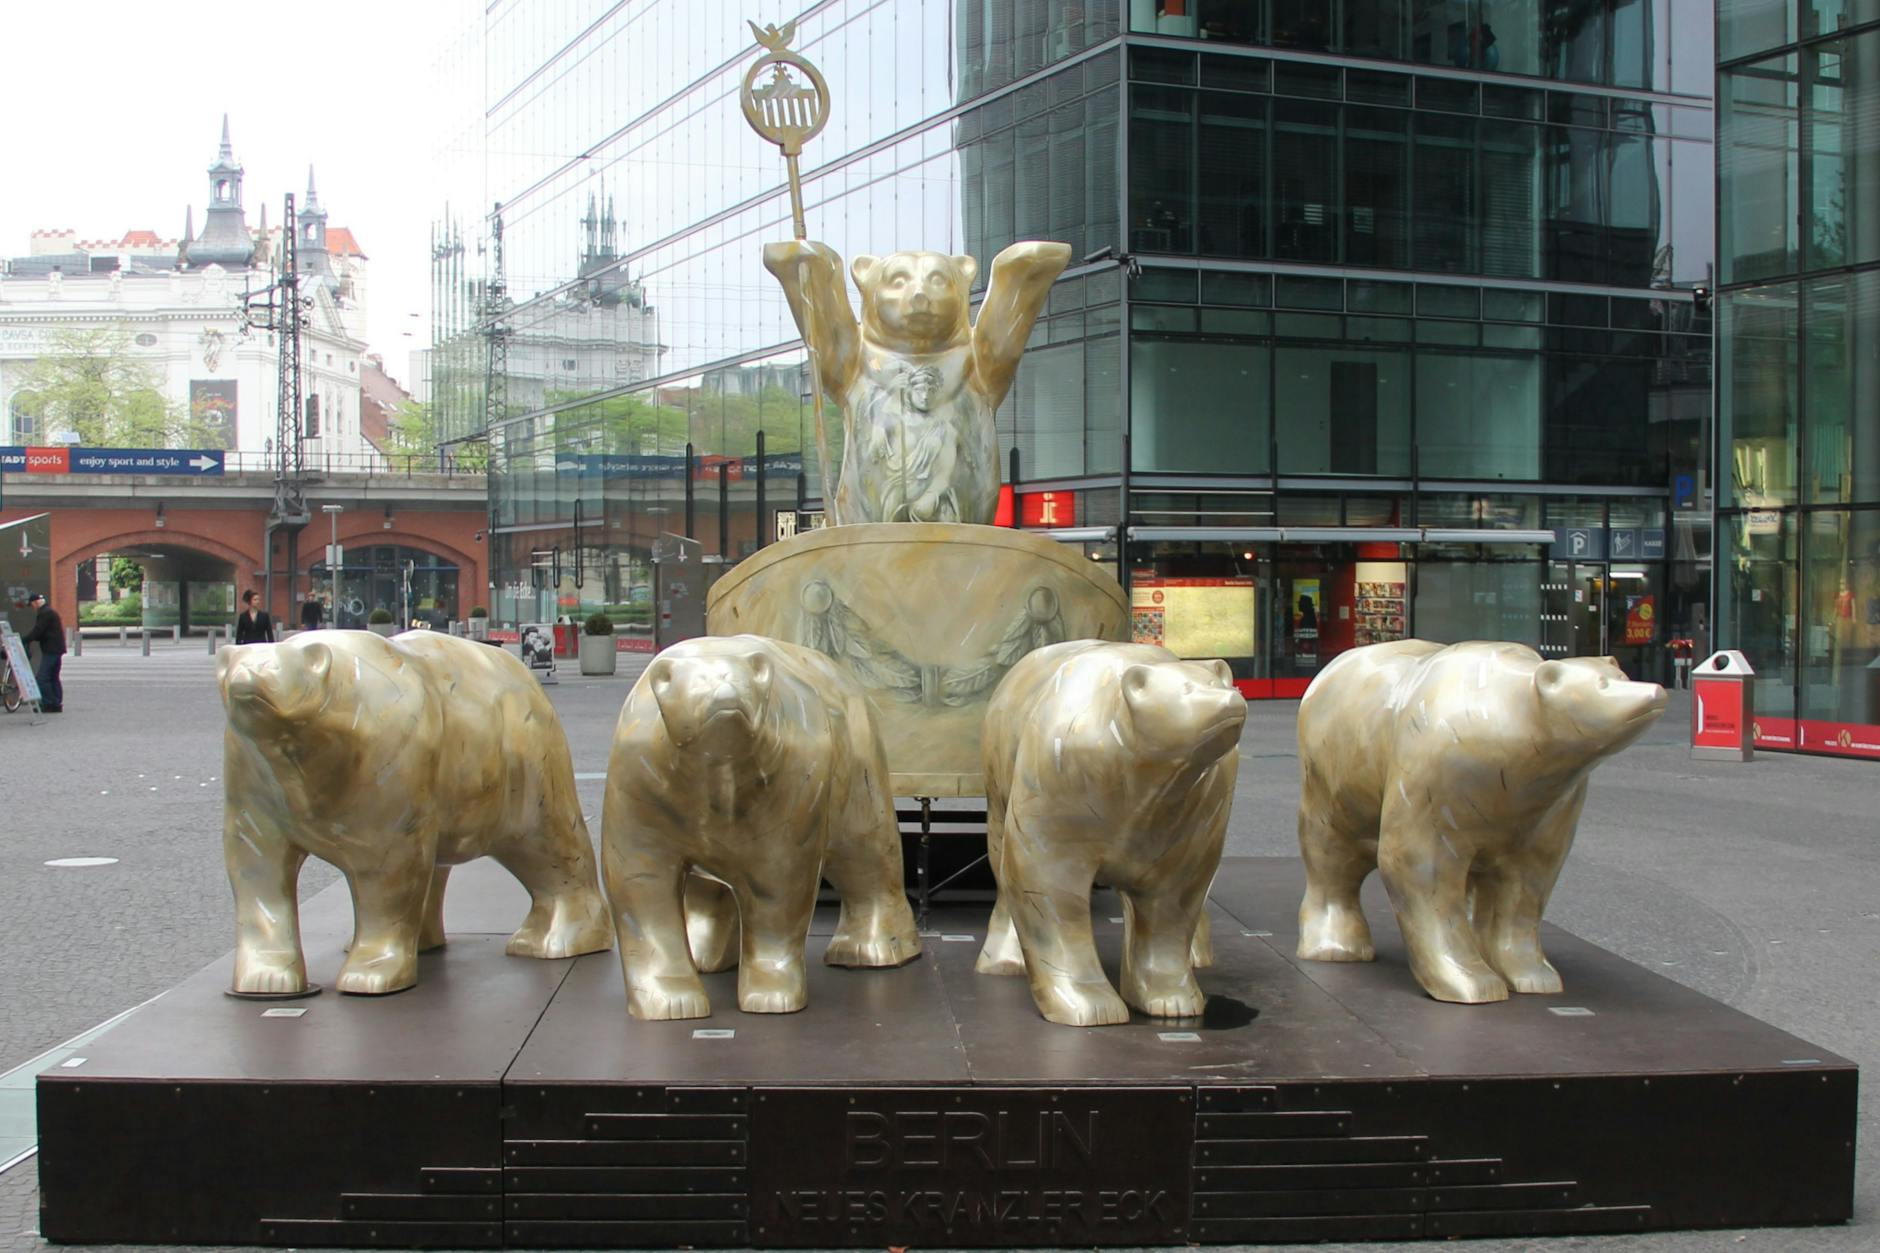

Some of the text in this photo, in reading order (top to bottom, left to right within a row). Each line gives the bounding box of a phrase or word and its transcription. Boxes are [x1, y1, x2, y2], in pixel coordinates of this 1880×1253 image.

[29, 455, 62, 467] sports
[80, 456, 180, 469] enjoy sport and style
[847, 1111, 1099, 1168] BERLIN
[775, 1190, 1169, 1223] NEUES KRANZLER ECK
